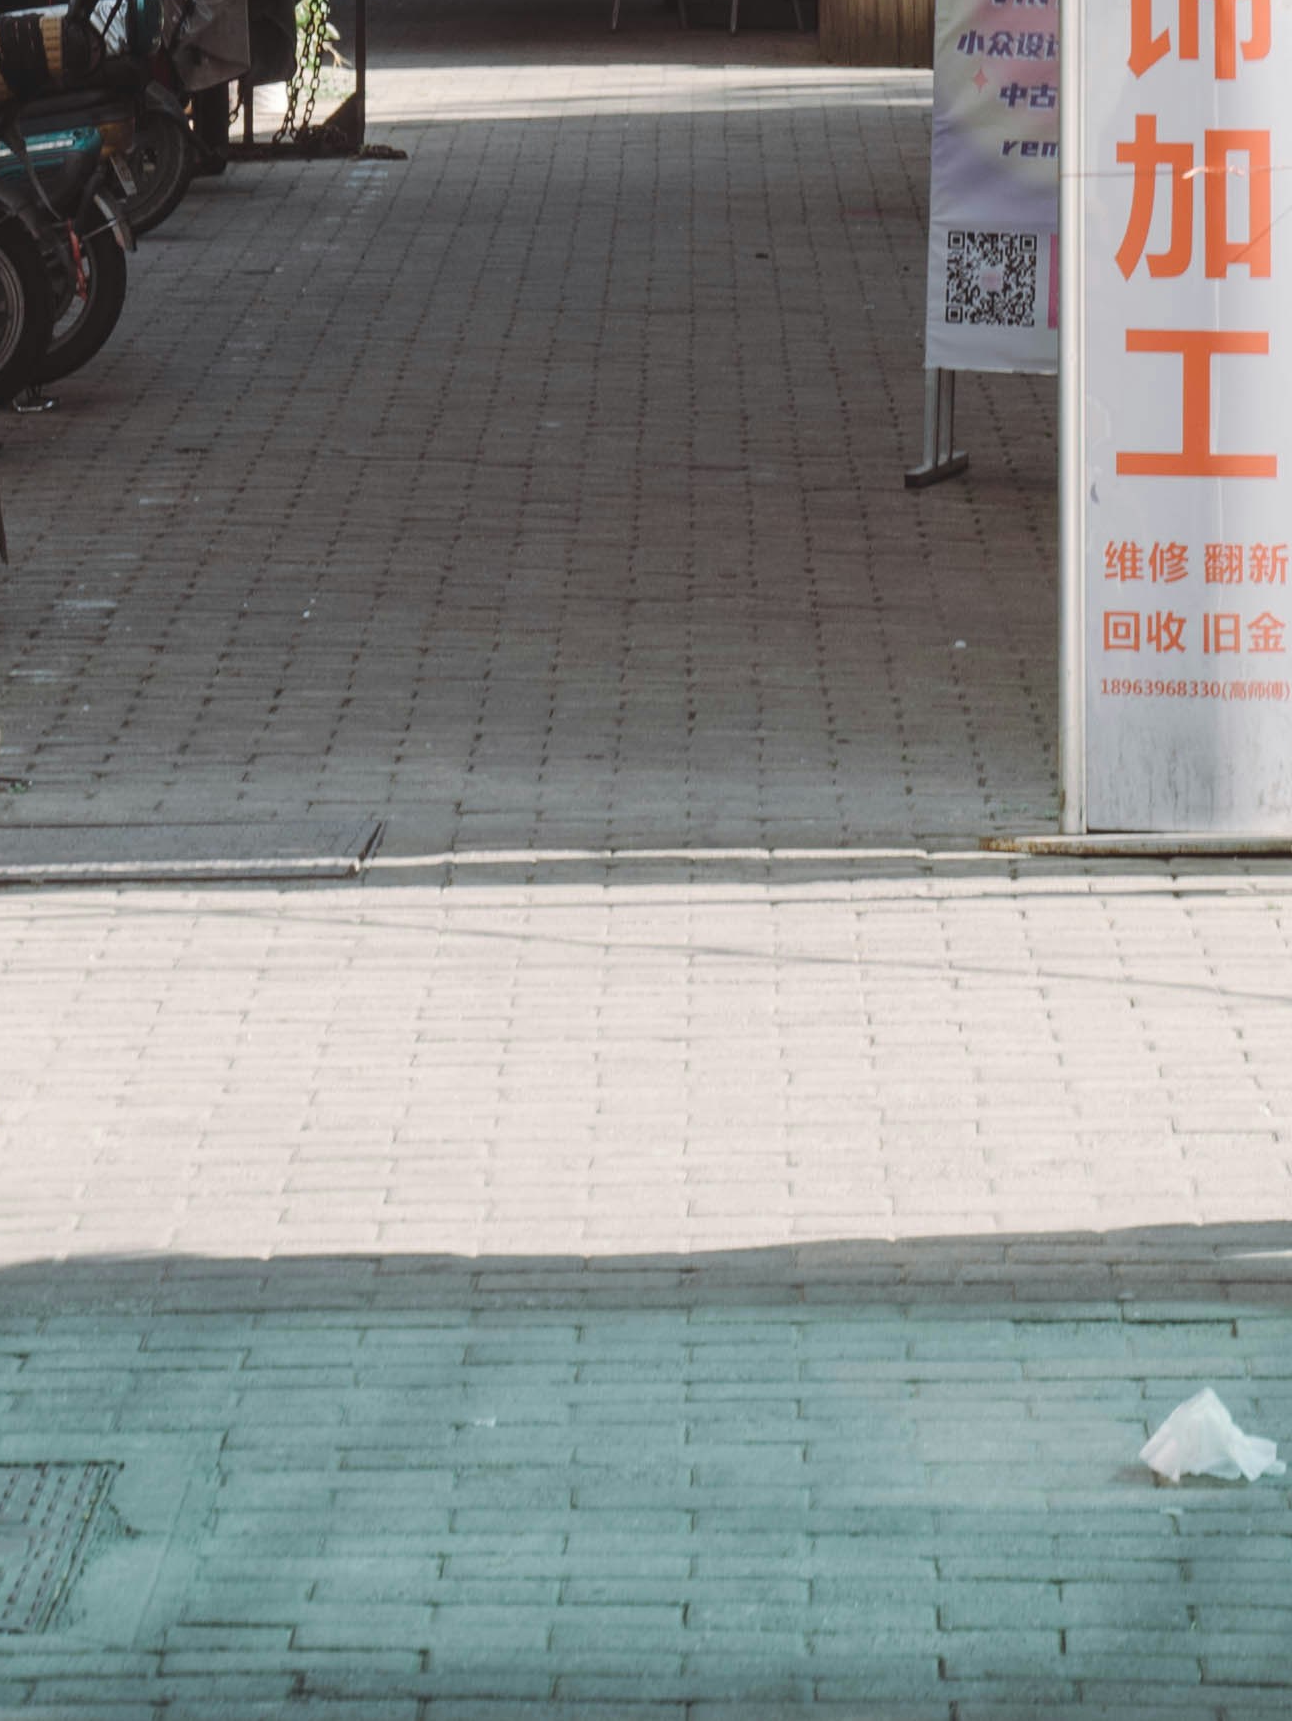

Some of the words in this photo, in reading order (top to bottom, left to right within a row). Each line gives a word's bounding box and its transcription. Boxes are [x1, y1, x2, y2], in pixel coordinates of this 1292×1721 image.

[1104, 541, 1189, 584] 维修
[1204, 542, 1289, 584] 翻新
[1103, 610, 1188, 653] 回收
[1203, 611, 1286, 654] 旧金
